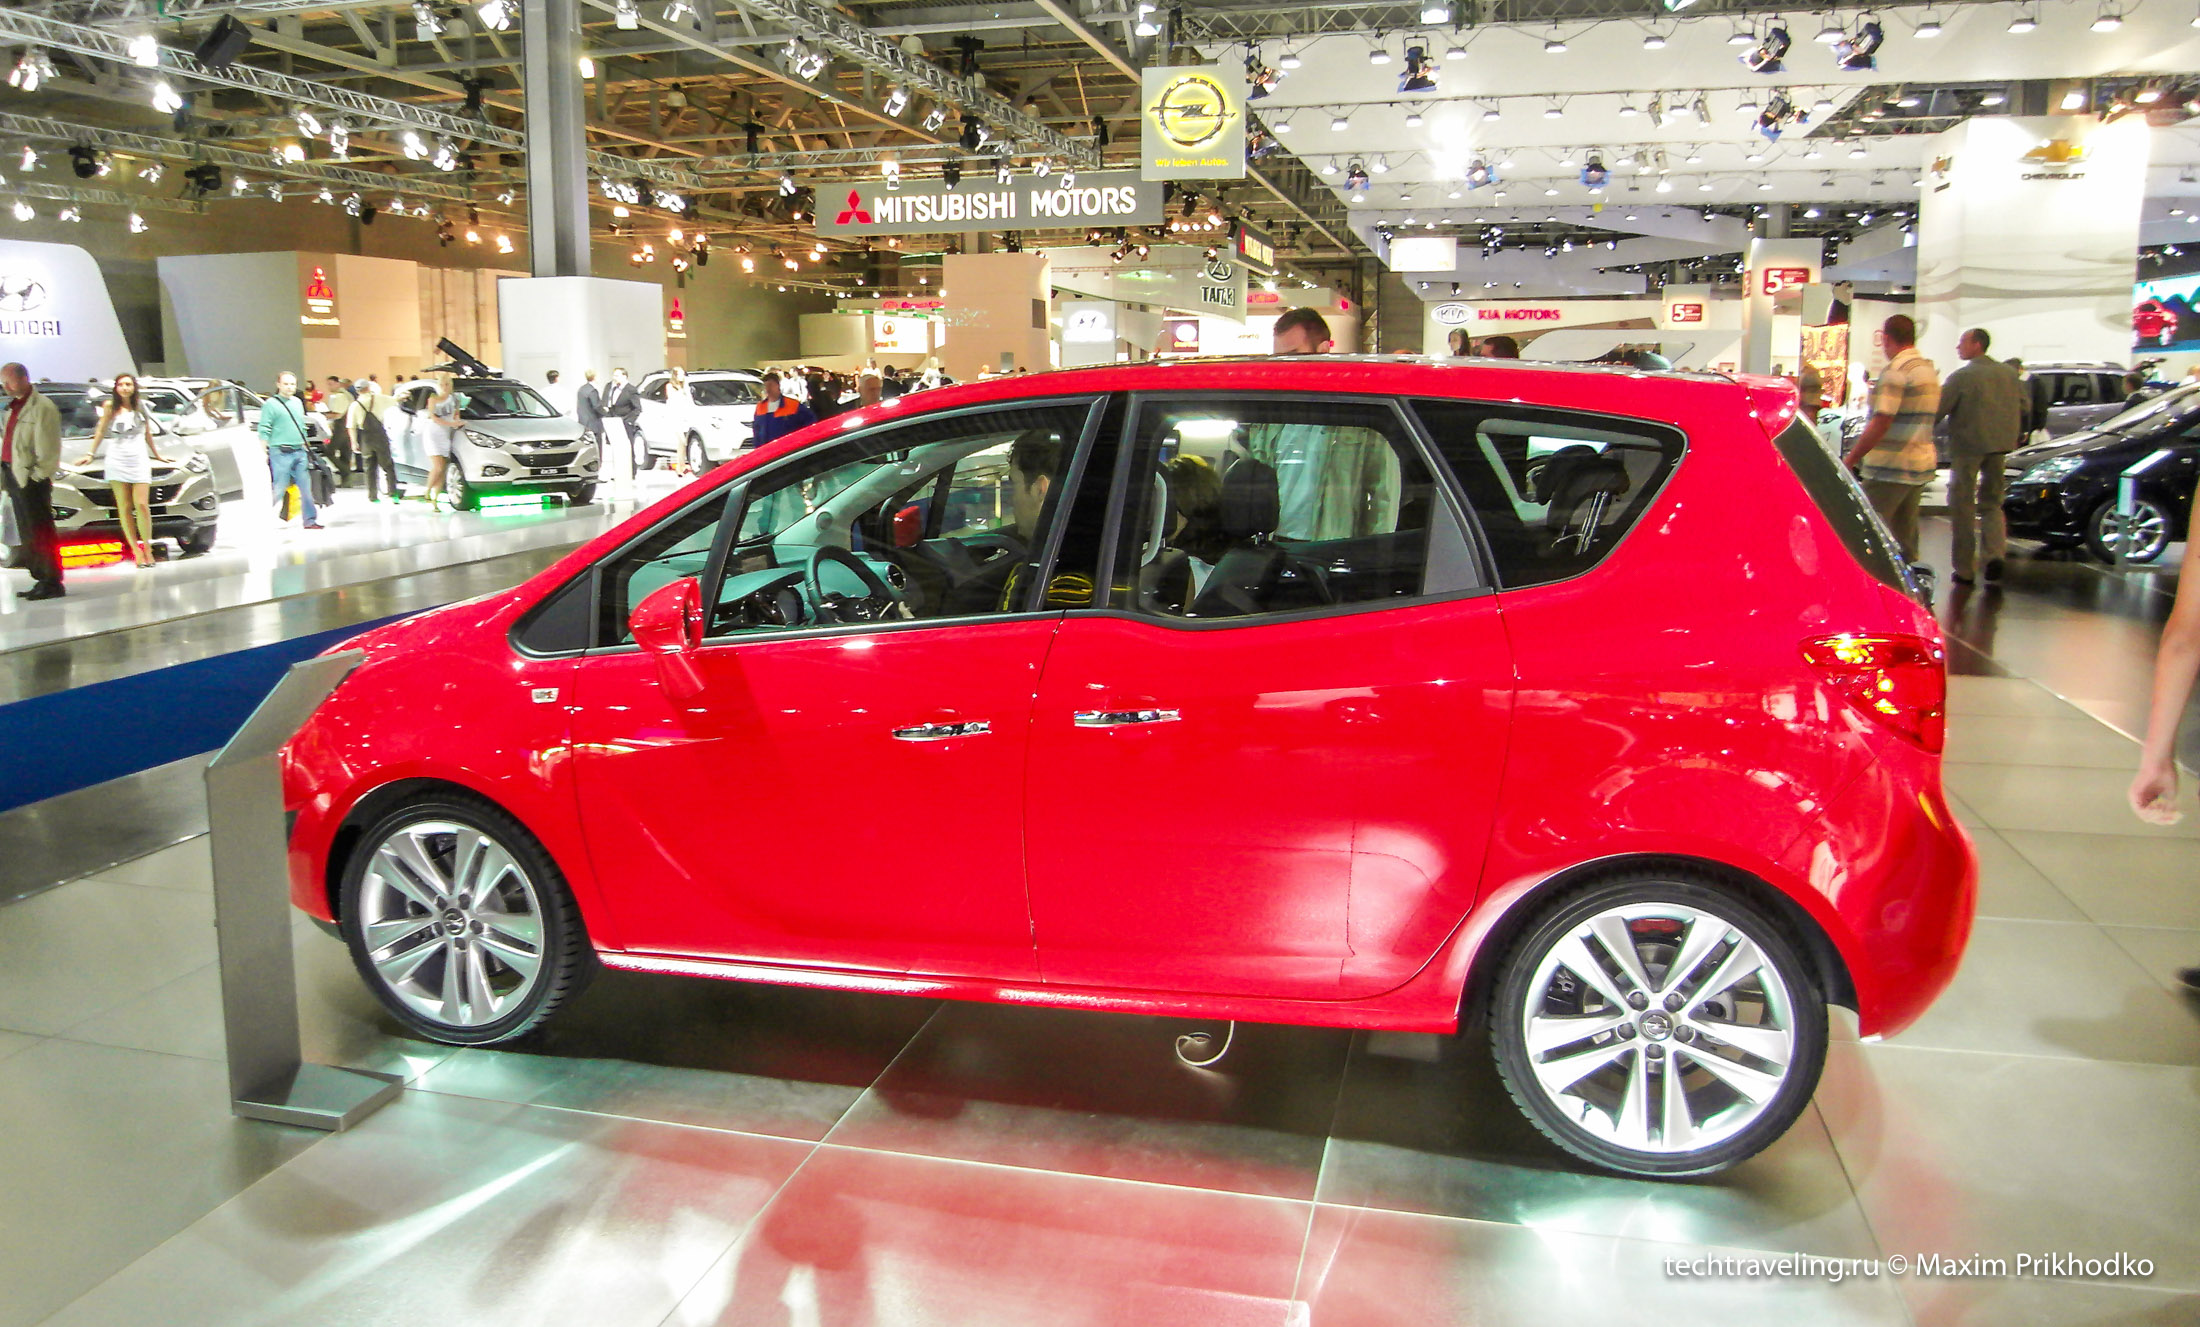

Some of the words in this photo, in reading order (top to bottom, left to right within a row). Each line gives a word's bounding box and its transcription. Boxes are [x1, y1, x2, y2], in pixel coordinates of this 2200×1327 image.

[2021, 172, 2086, 181] CHEVROLET
[873, 192, 1016, 223] MITSUBISHI
[1030, 186, 1137, 218] MOTORS
[1765, 269, 1783, 294] 5
[1477, 309, 1501, 321] KIA
[1504, 308, 1561, 321] MOTORS
[1673, 304, 1686, 321] 5
